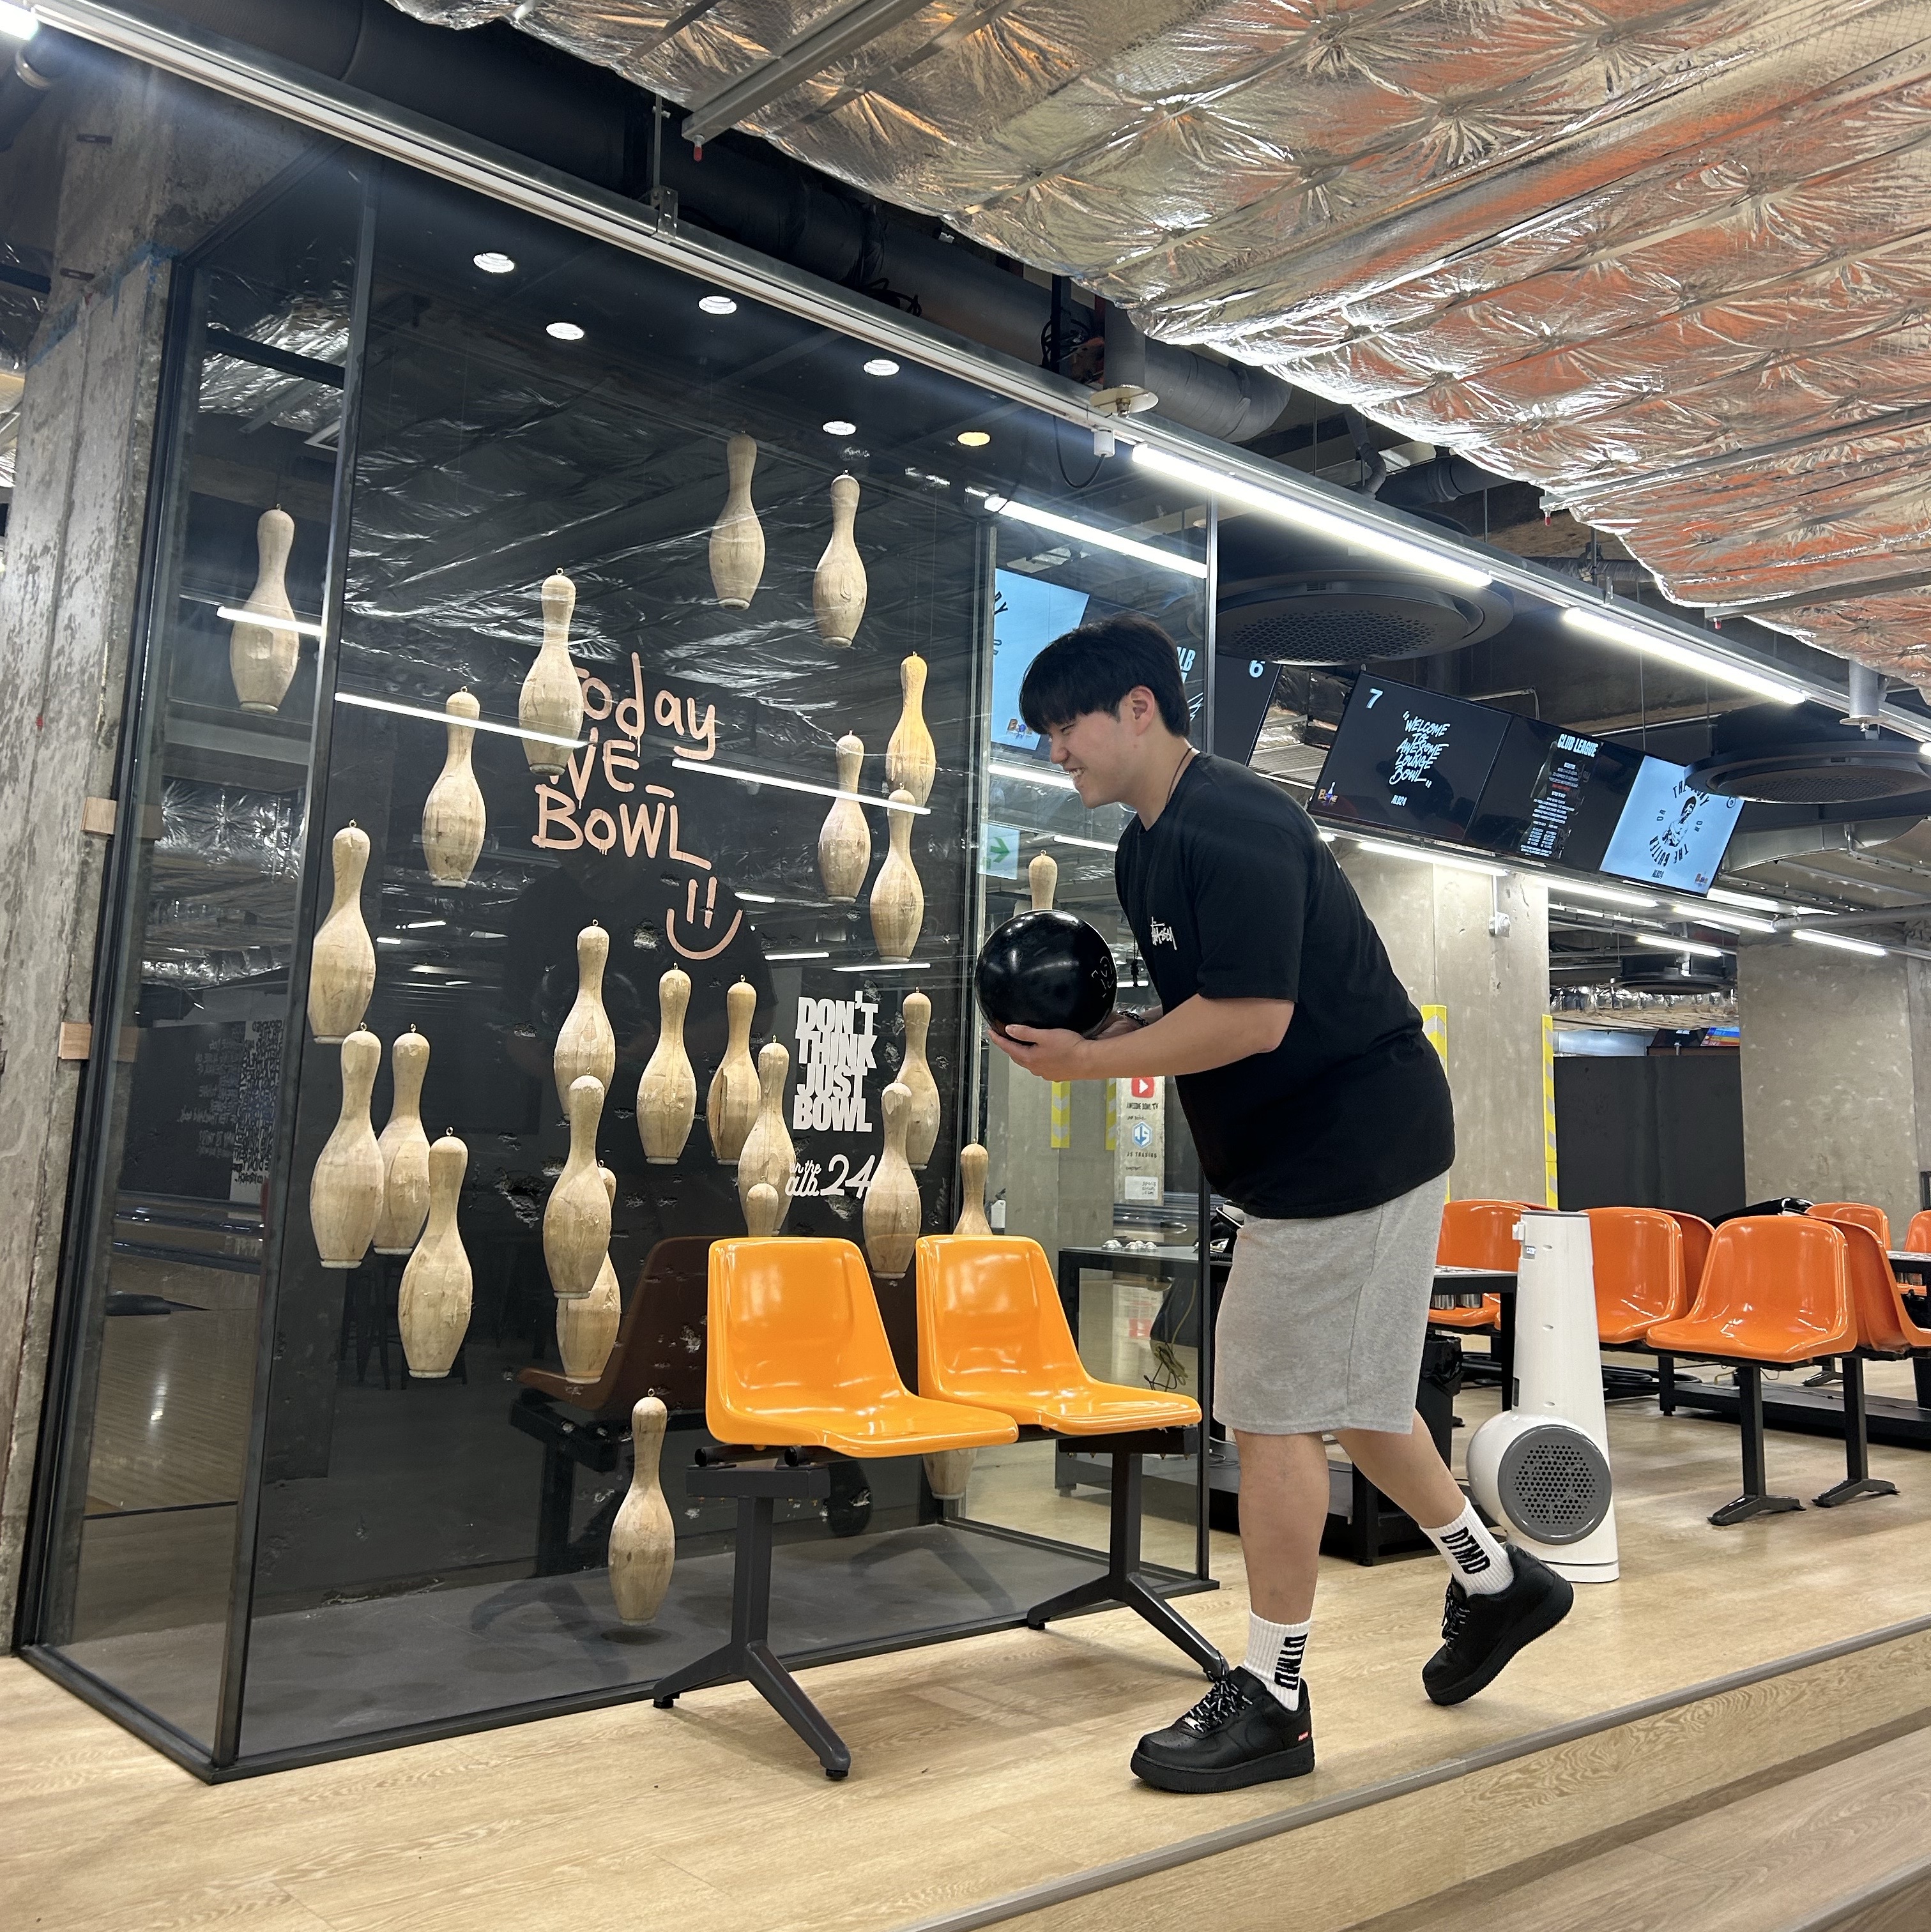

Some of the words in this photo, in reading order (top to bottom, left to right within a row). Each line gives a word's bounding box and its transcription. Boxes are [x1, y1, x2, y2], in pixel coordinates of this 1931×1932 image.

[1249, 660, 1265, 678] 6
[576, 651, 716, 760] oday
[1366, 688, 1383, 708] 7
[1395, 754, 1437, 769] LOUNGE
[1396, 738, 1449, 759] AWESOME
[1557, 733, 1576, 751] CLUB
[1573, 738, 1598, 757] LEAGUE
[531, 783, 711, 870] BOWL
[798, 990, 878, 1036] DON'T
[795, 1029, 878, 1069] THINK
[797, 1063, 868, 1099] JUST
[793, 1095, 872, 1132] BOWL
[820, 1153, 876, 1199] 24
